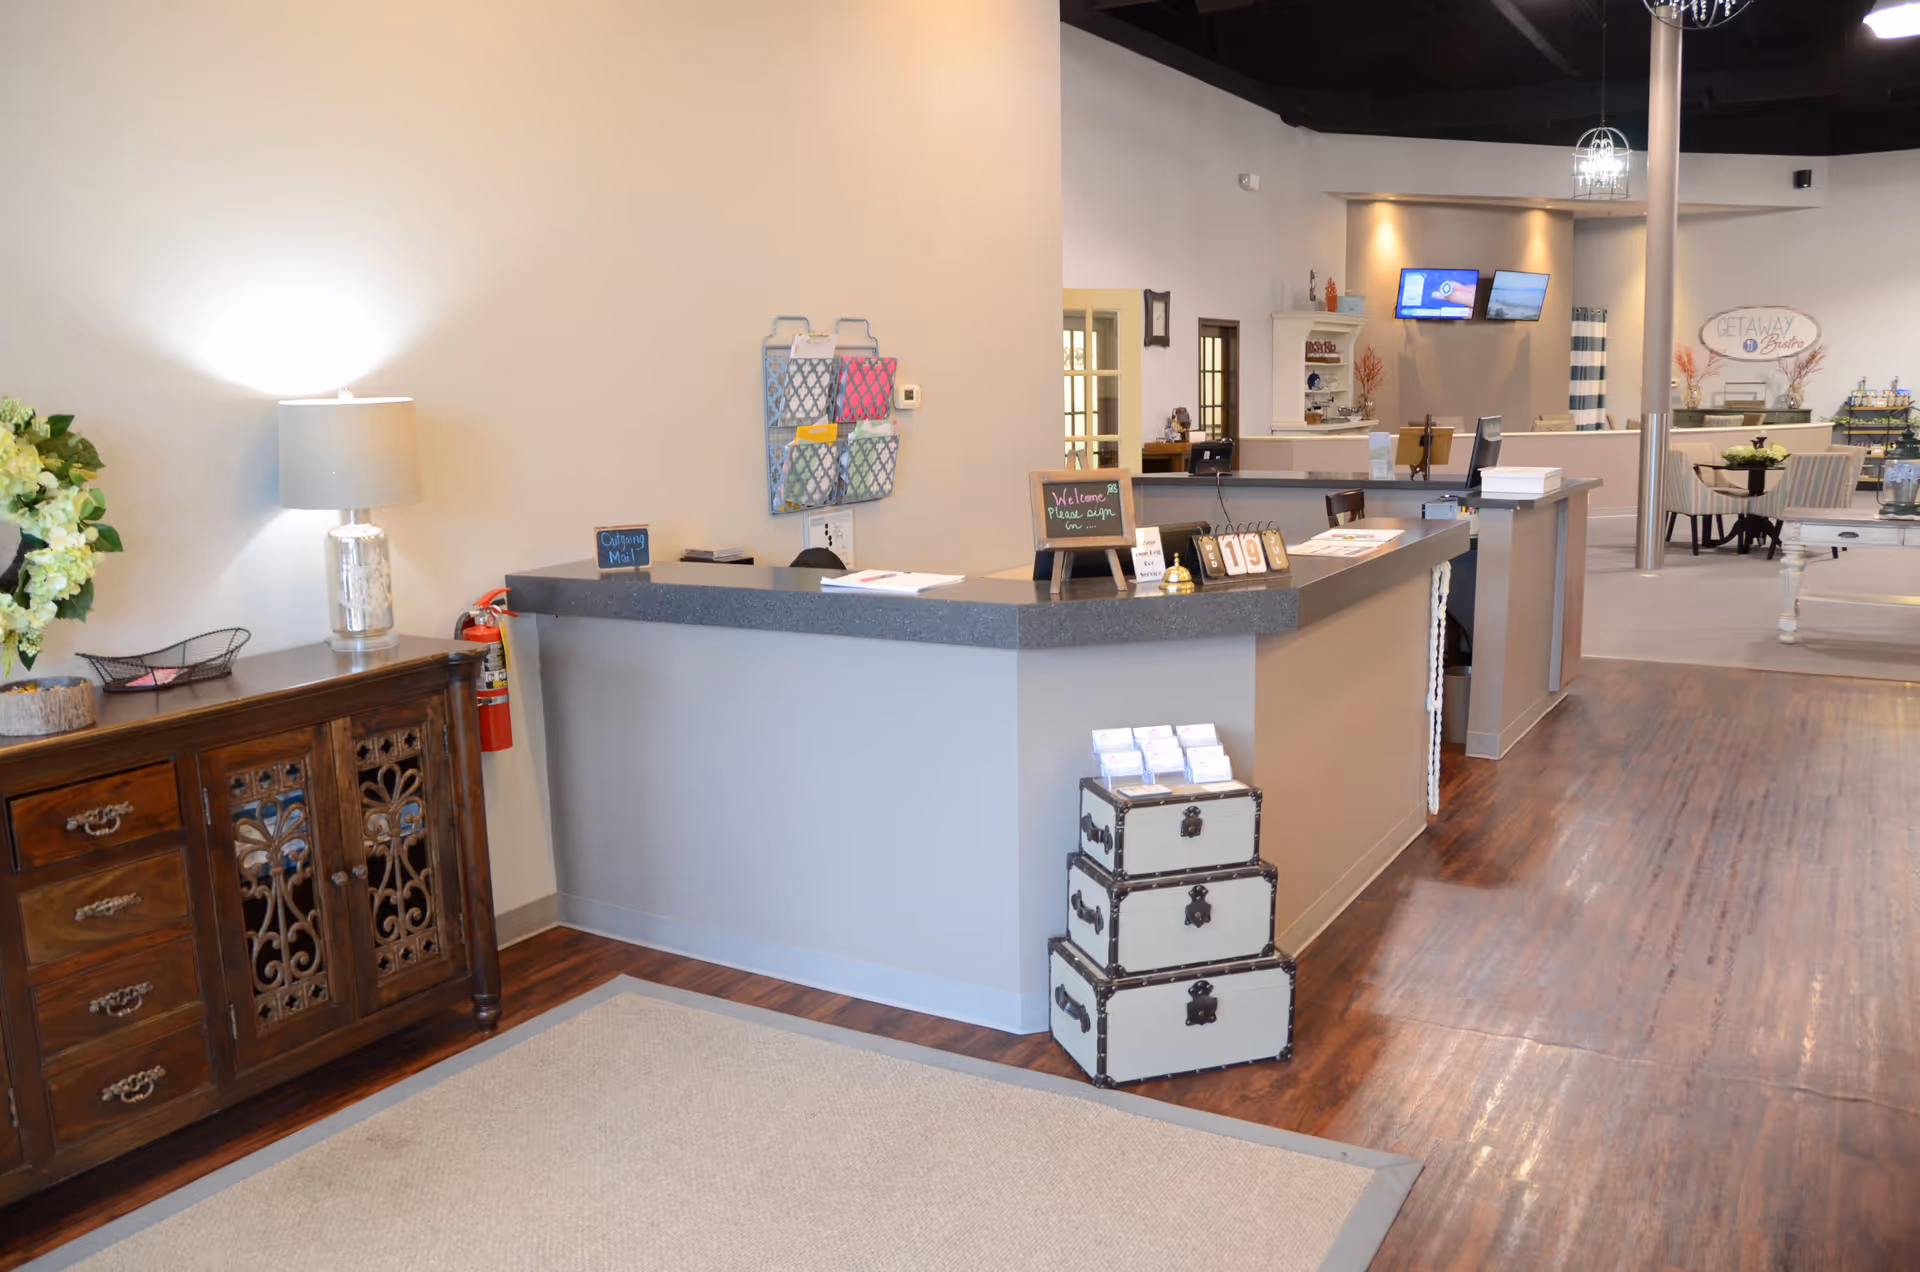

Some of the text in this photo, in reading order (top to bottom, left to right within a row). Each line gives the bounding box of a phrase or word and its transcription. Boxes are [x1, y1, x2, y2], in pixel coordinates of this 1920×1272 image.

[1717, 316, 1794, 337] GETAWAY
[1760, 333, 1806, 355] Bistro
[1052, 488, 1106, 506] Welcome
[1048, 507, 1116, 520] Please sign
[601, 532, 645, 551] Outgoing
[1270, 536, 1282, 565] JUL
[608, 548, 635, 565] Mail
[1205, 544, 1218, 568] WED
